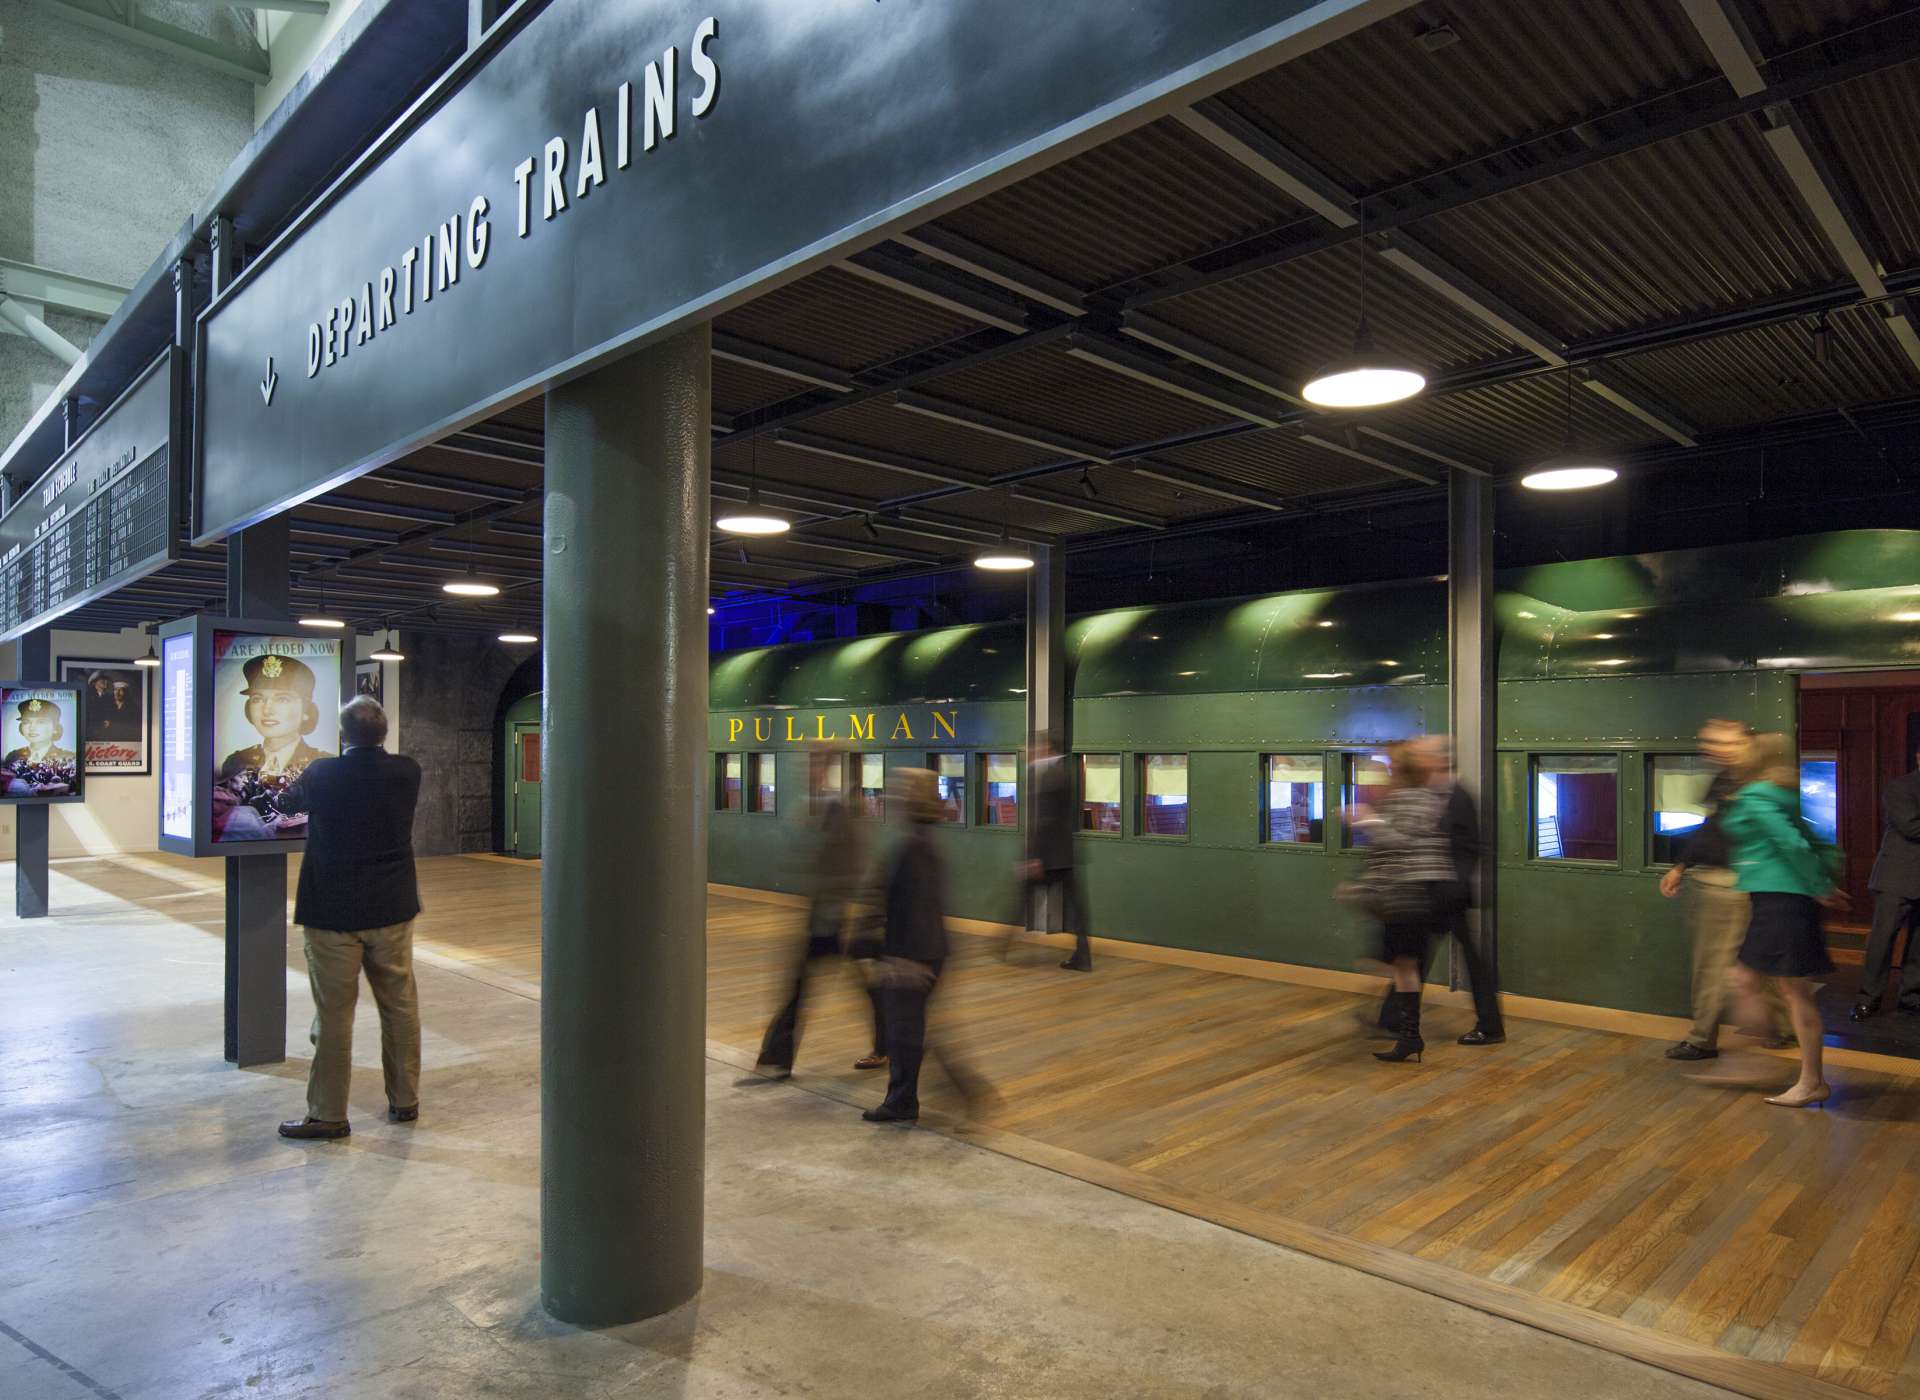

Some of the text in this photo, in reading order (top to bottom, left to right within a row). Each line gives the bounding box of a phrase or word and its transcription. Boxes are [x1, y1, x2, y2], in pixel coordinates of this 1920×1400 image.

[306, 15, 719, 379] DEPARTING TRAINS
[231, 644, 255, 657] ARE
[260, 643, 305, 656] NEEDED
[310, 643, 336, 654] NOW
[728, 711, 958, 742] PULLMAN
